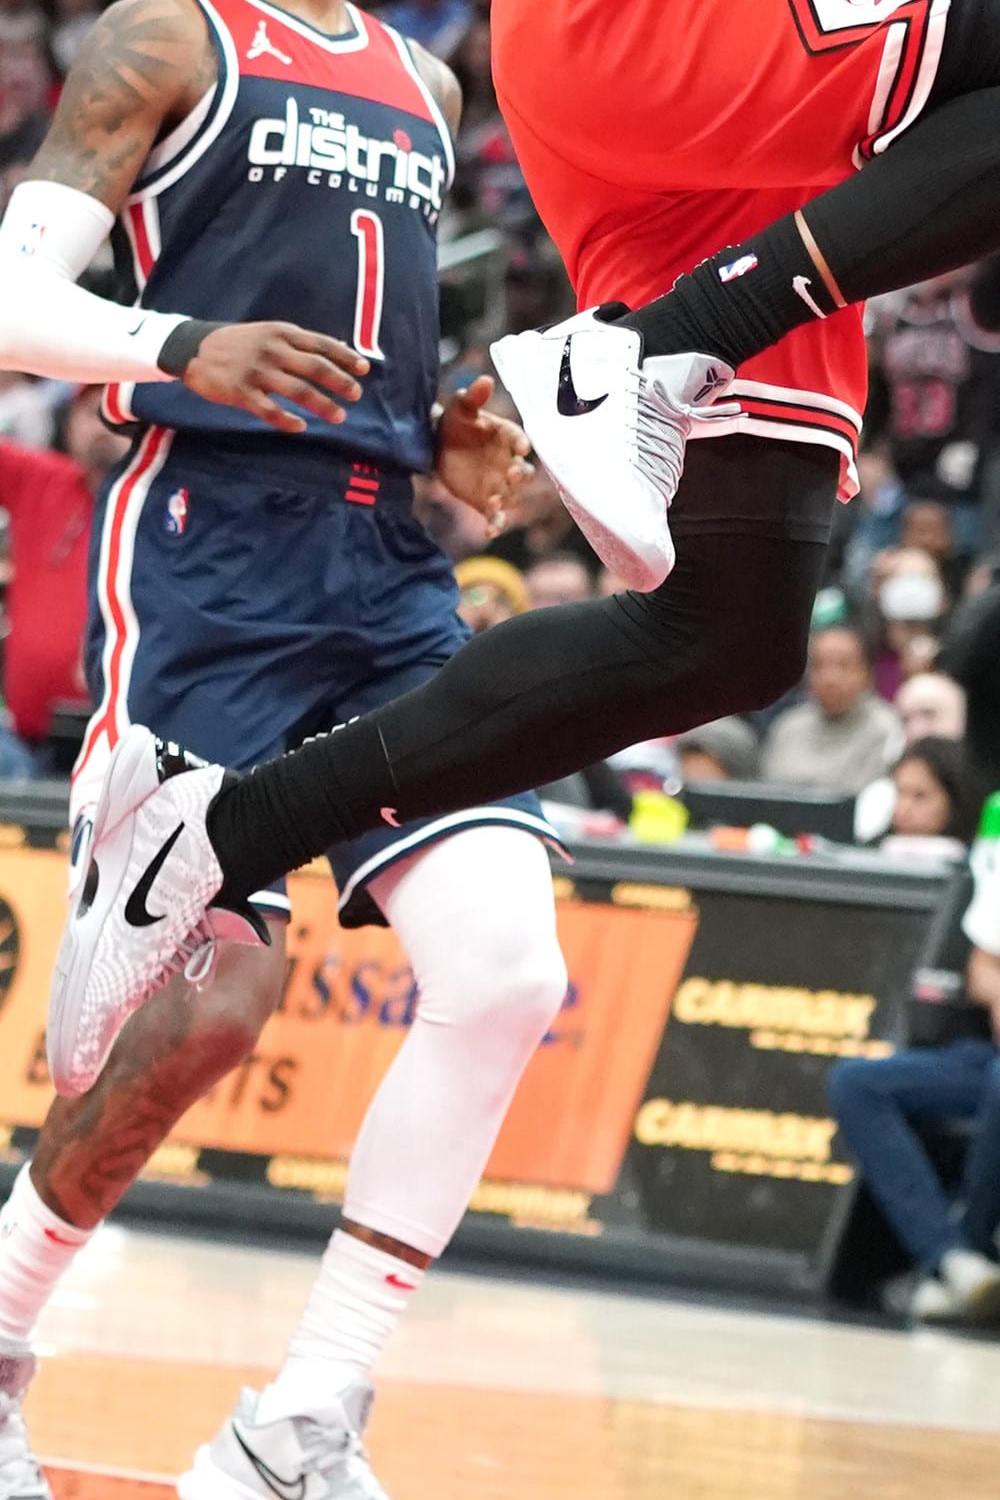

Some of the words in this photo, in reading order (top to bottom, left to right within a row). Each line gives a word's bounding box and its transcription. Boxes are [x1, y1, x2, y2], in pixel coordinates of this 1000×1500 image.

[309, 107, 345, 130] THE
[248, 97, 445, 210] district
[248, 166, 287, 183] OF
[351, 208, 384, 361] 1
